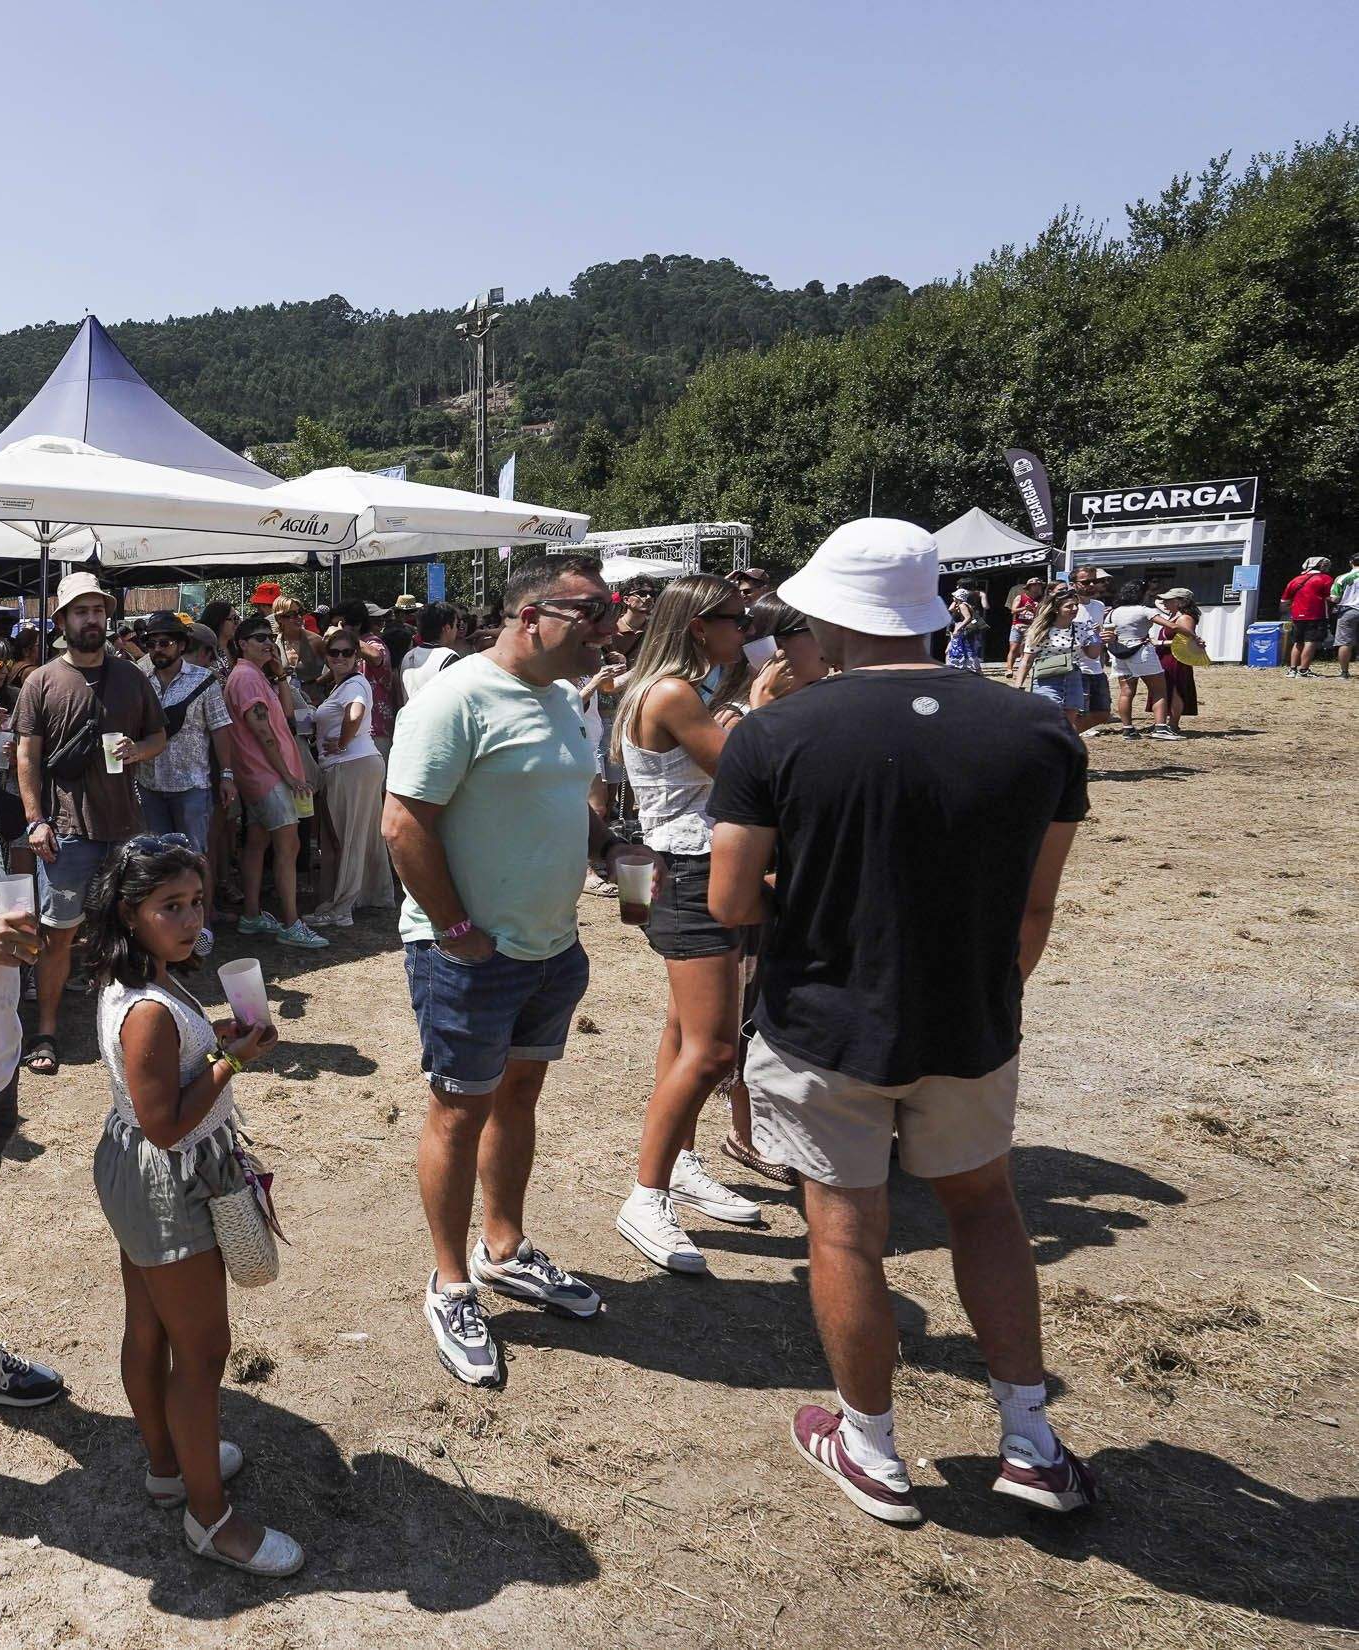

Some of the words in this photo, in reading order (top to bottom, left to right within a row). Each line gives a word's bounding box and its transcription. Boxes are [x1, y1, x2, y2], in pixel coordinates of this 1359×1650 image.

[1019, 478, 1048, 528] RECARGAS
[1081, 484, 1242, 515] RECARGA
[951, 551, 1047, 571] CASHLESS
